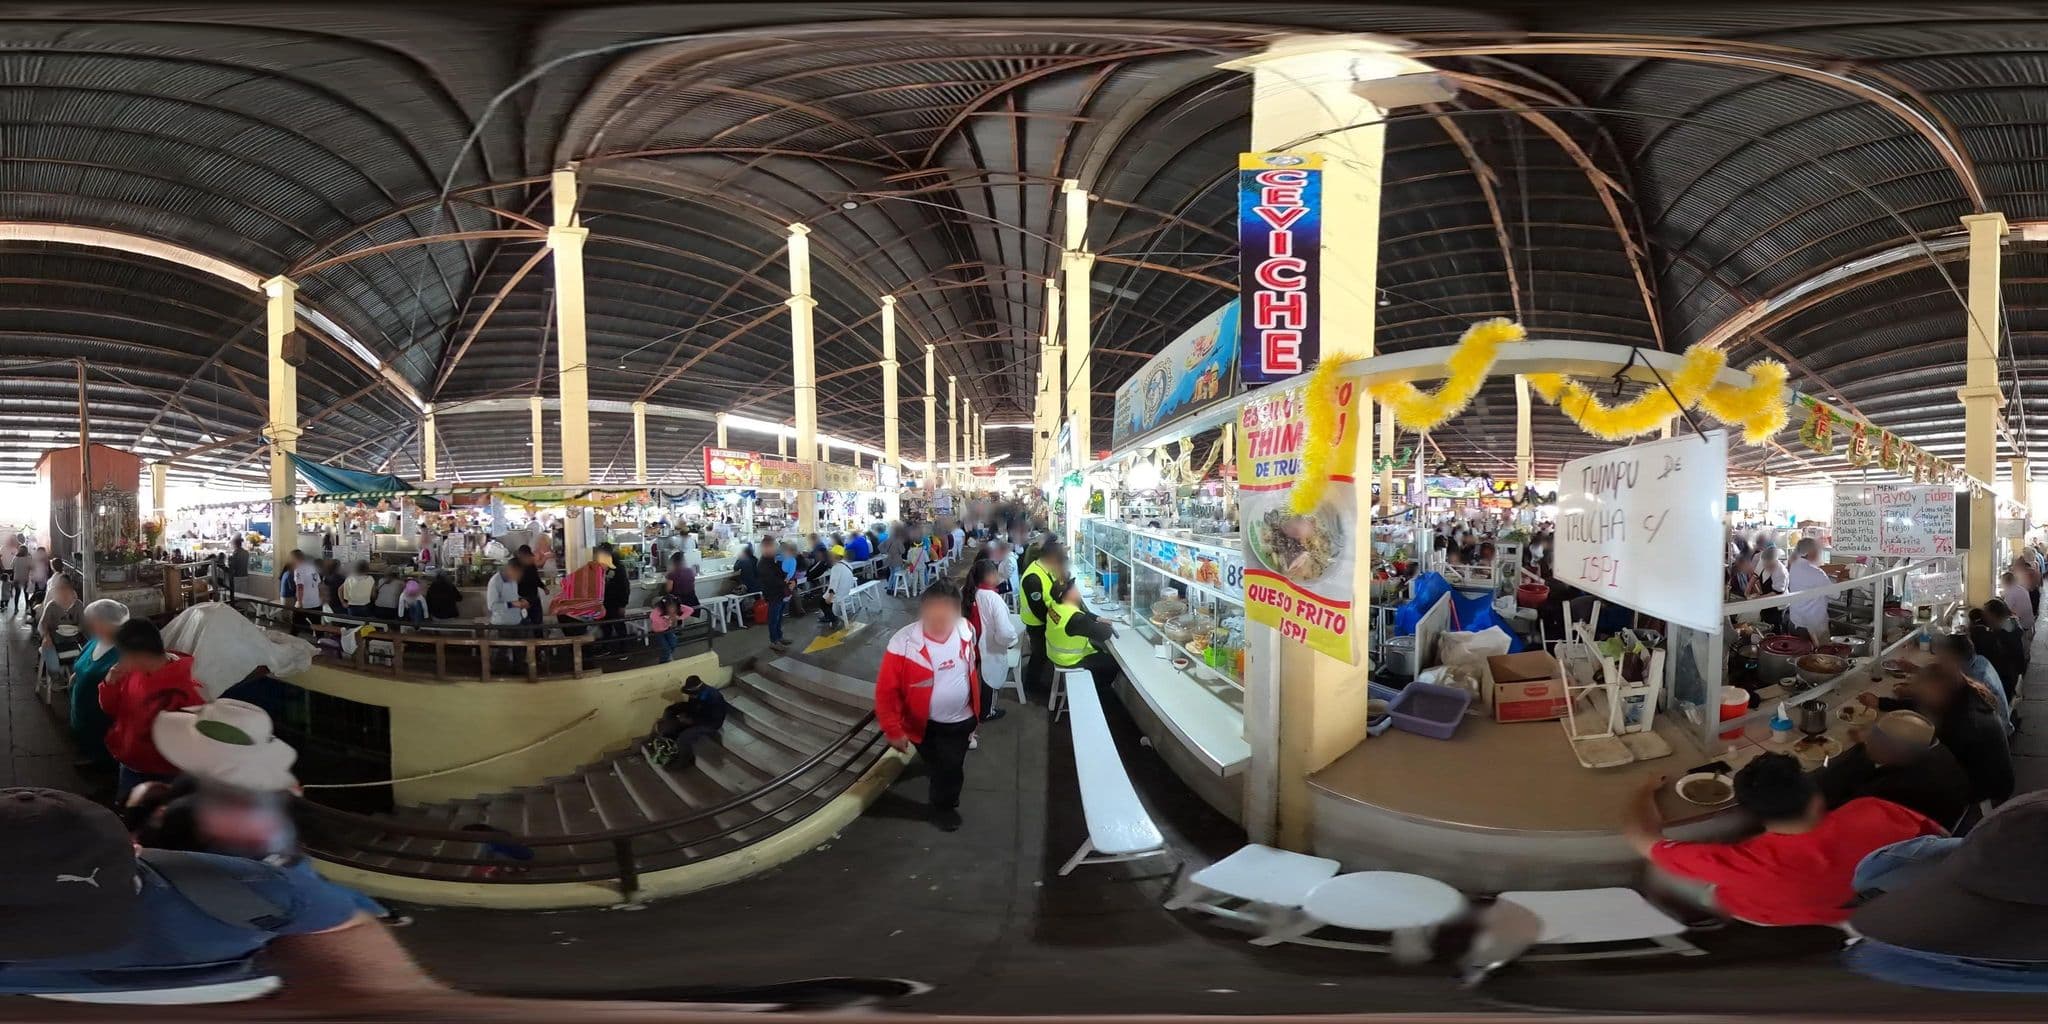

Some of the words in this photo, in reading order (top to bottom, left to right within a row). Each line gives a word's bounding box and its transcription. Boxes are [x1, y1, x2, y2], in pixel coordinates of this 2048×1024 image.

[1253, 170, 1310, 374] CEVICHE
[1255, 461, 1270, 478] DE
[1581, 460, 1640, 501] THIMPU
[1565, 508, 1626, 545] TRUCHA
[1579, 554, 1619, 588] ISPI
[1248, 583, 1293, 613] QUESO
[1296, 598, 1347, 635] FRITO
[1279, 616, 1307, 645] ISPI
